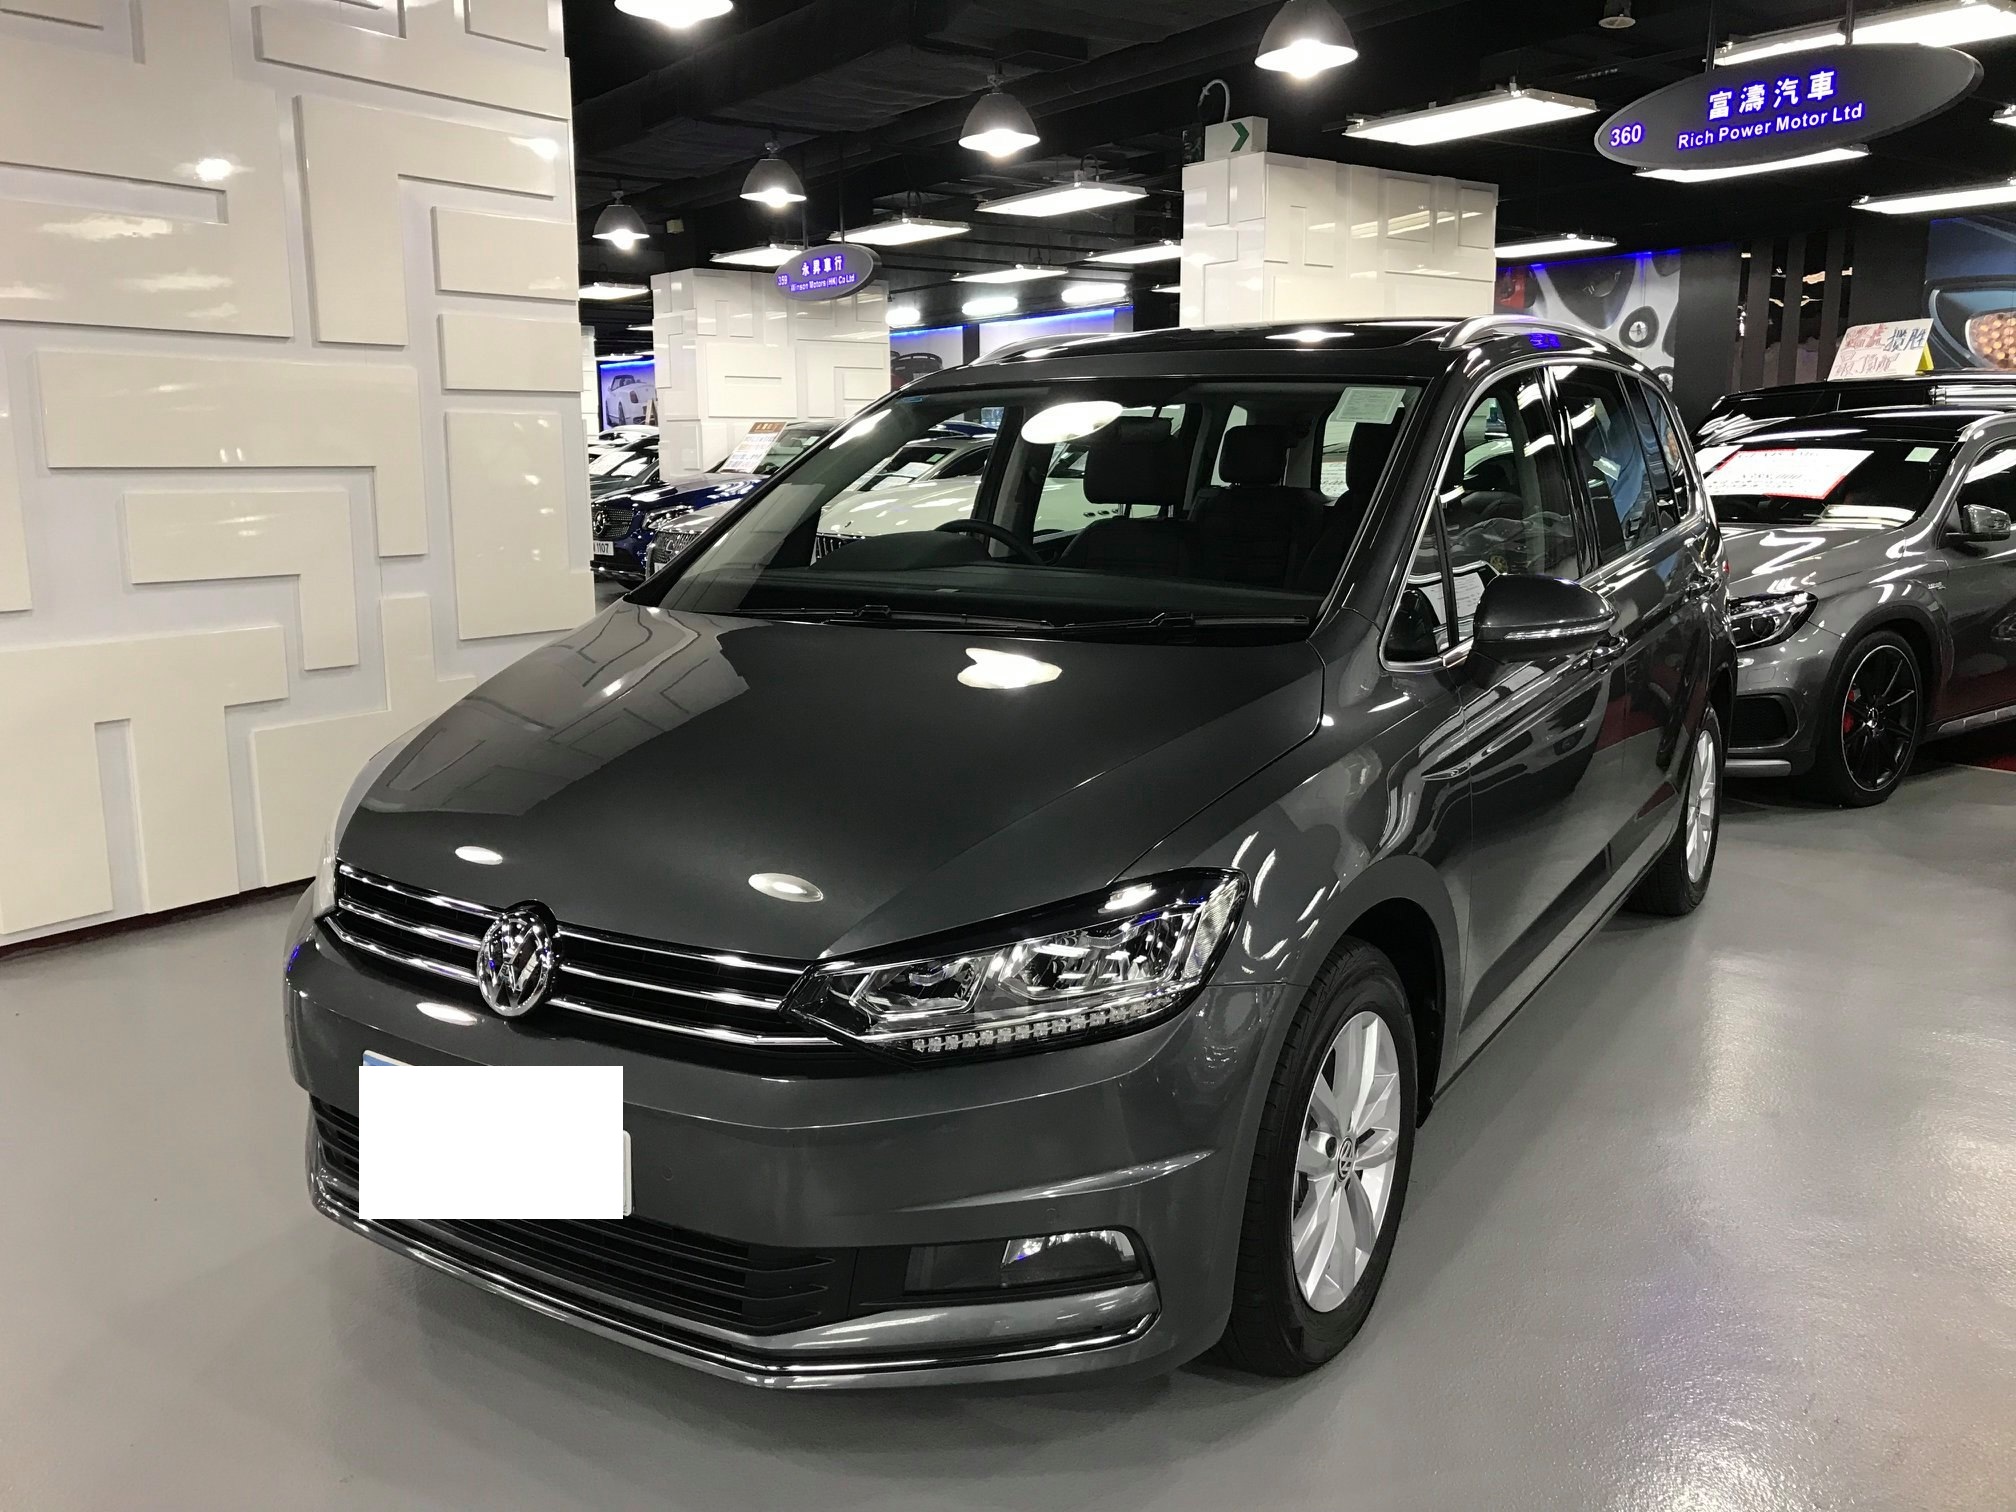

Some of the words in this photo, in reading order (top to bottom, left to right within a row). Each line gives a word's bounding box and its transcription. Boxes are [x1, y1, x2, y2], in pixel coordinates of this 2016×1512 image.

[1709, 70, 1835, 120] 富濤汽車
[1610, 123, 1643, 148] 360
[1677, 131, 1715, 149] Rich
[1718, 121, 1772, 142] Power
[1775, 112, 1829, 133] Motor
[1832, 102, 1863, 123] Ltd
[777, 275, 788, 286] 359
[809, 279, 827, 289] Motors
[838, 275, 846, 285] Co
[846, 273, 855, 283] Ltd
